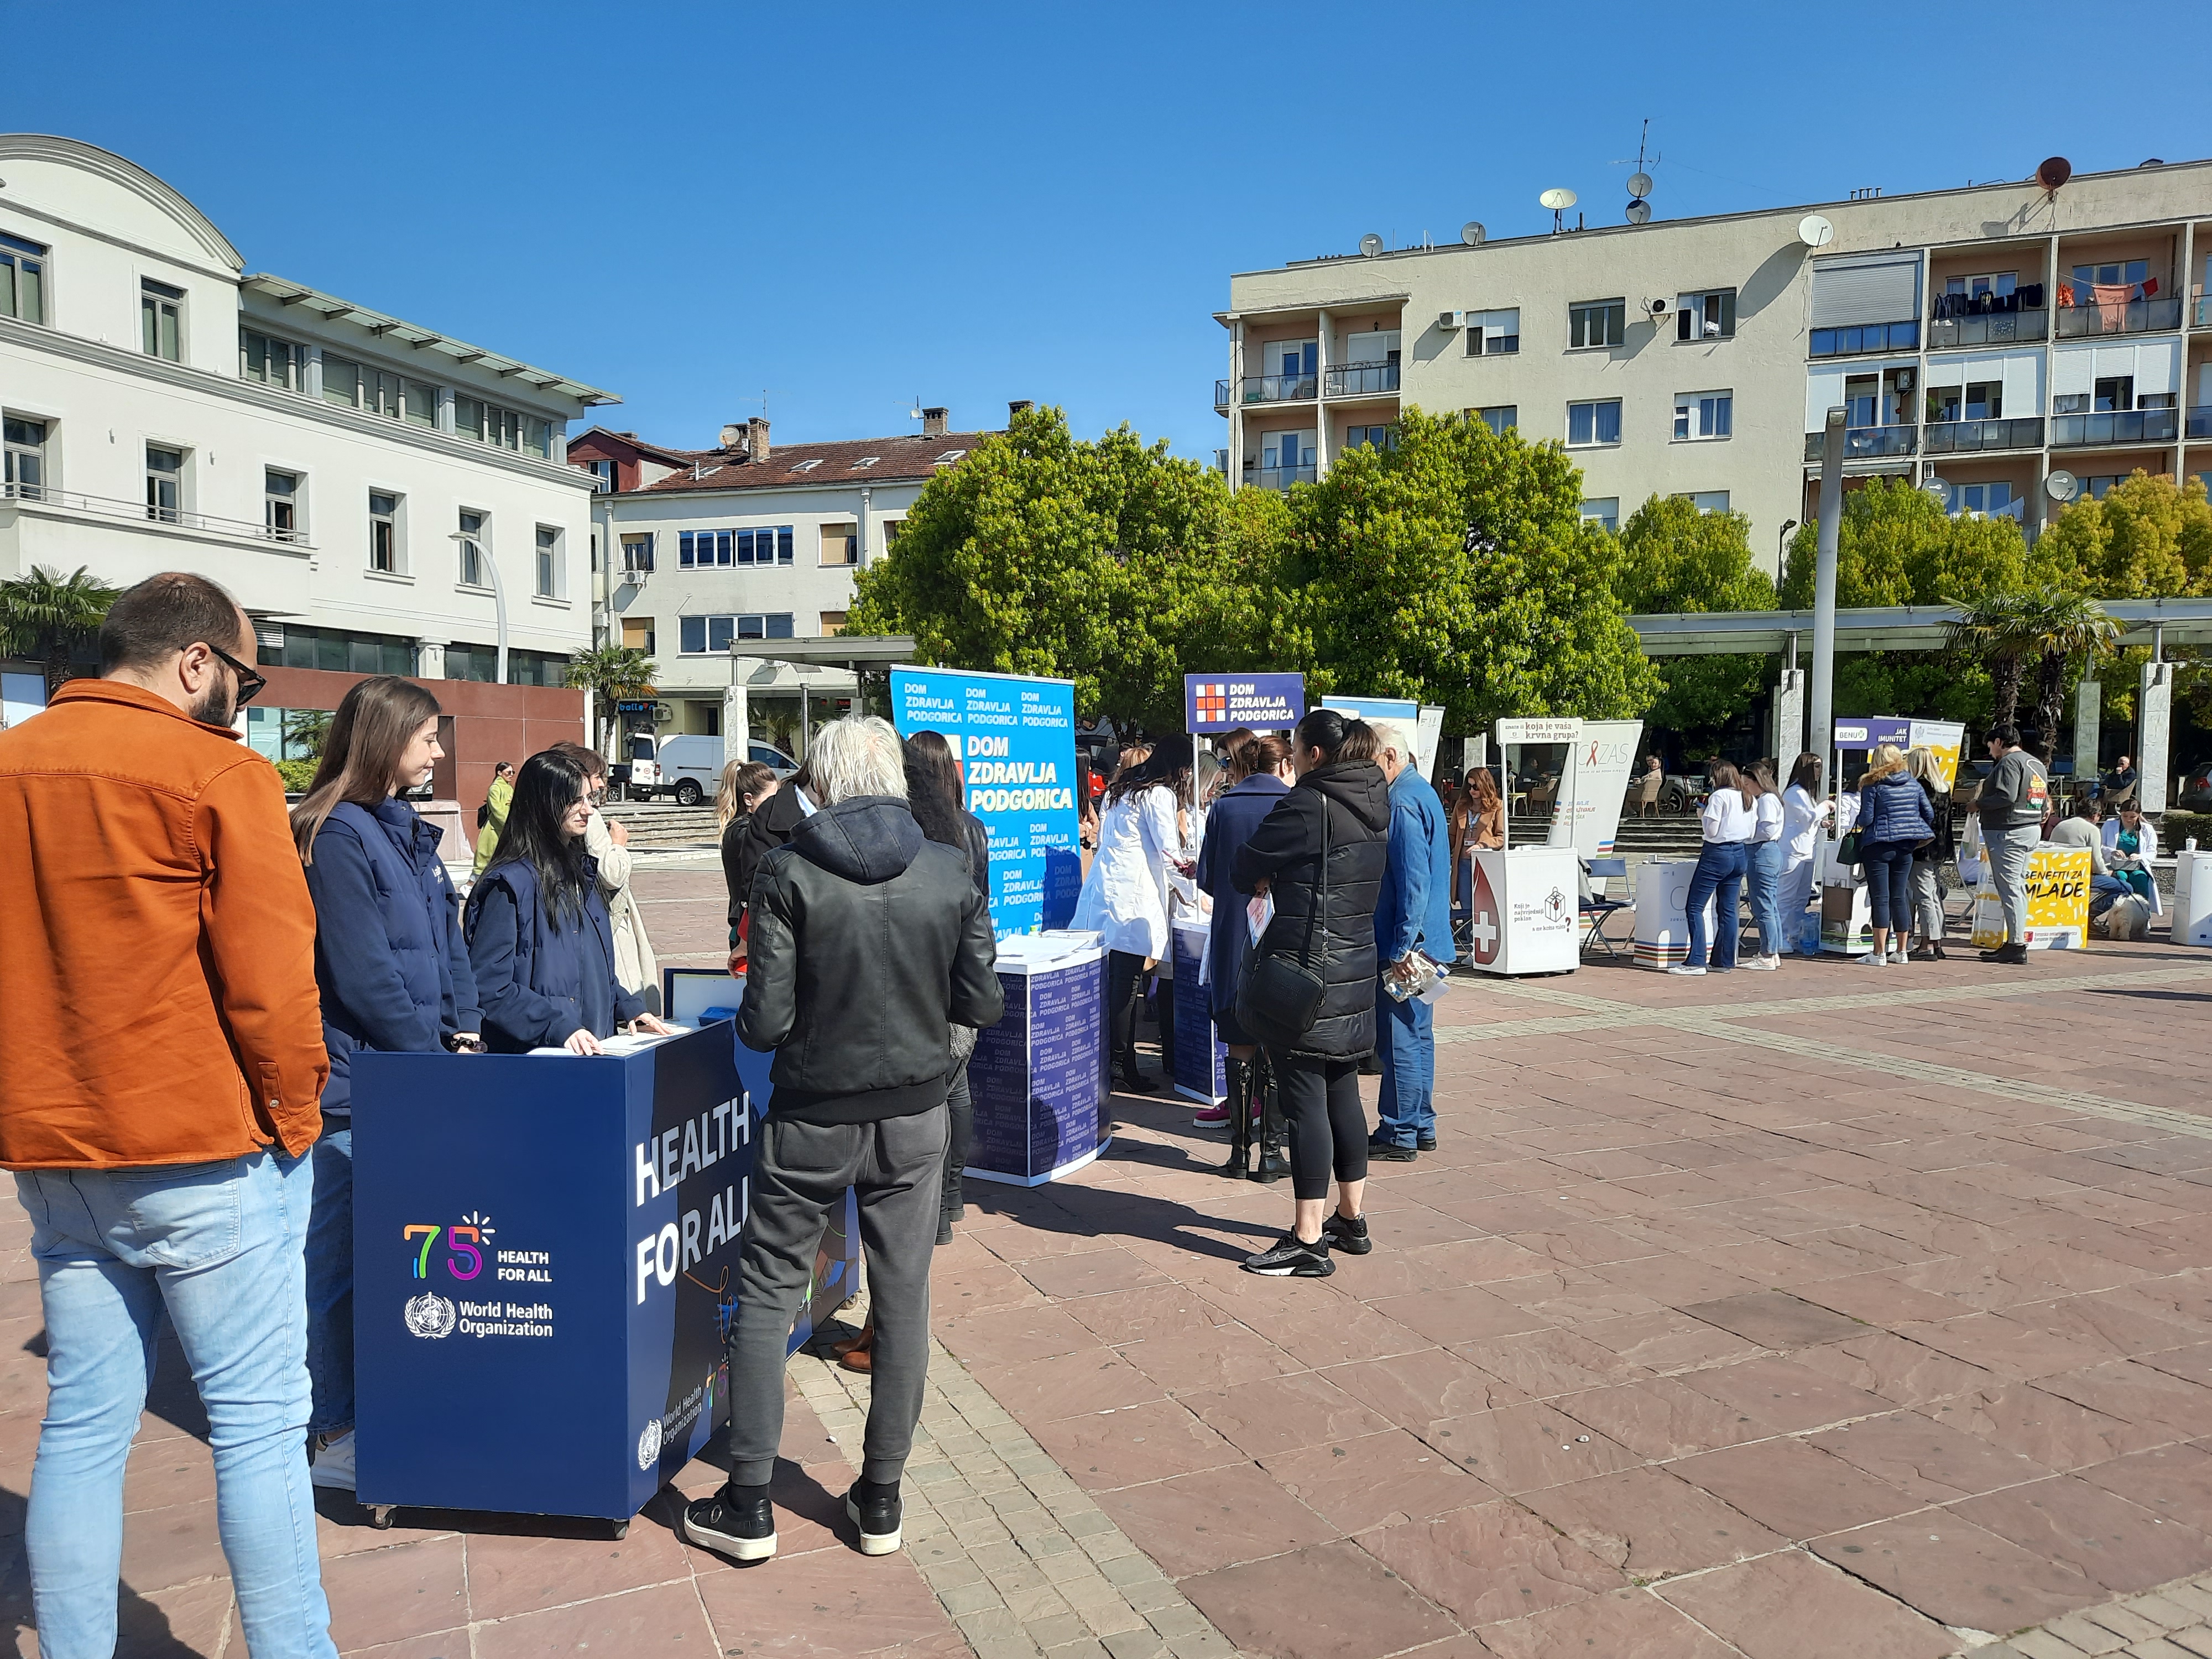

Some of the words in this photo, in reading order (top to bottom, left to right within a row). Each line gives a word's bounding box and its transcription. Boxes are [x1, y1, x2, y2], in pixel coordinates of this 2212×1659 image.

[904, 683, 927, 694] DOM
[966, 688, 986, 698] DOM
[1229, 684, 1255, 695] DOM
[905, 696, 954, 709] ZDRAVLJA
[1021, 692, 1039, 702] DOM
[1229, 696, 1286, 708] ZDRAVLJA
[966, 700, 1011, 712] ZDRAVLJA
[1021, 703, 1062, 715] ZDRAVLJA
[907, 710, 963, 723] PODGORICA
[967, 713, 1018, 726] PODGORICA
[1230, 709, 1294, 722] PODGORICA
[1022, 716, 1068, 728] PODGORICA
[1525, 722, 1543, 732] koja
[1546, 722, 1553, 732] je
[1554, 722, 1572, 730] vaša
[1525, 731, 1551, 739] krvna
[1553, 731, 1578, 740] grupa?
[968, 735, 1009, 758] DOM
[968, 761, 1057, 785] ZDRAVLJA
[969, 787, 1073, 812] PODGORICA
[1029, 823, 1047, 833] DOM
[988, 837, 1019, 848] RAVLJA
[1030, 833, 1068, 846] ZDRAVLJA
[989, 849, 1026, 862] DGORICA
[1031, 844, 1077, 858] PODGORICA
[1003, 869, 1022, 880] DOM
[1055, 865, 1072, 875] DOM
[2070, 870, 2083, 879] ZA
[1003, 879, 1045, 894] ZDRAVLJA
[1003, 891, 1051, 906] PODGORICA
[1065, 965, 1086, 976] ZDRAVLJA
[1031, 972, 1060, 983] ZDRAVLJA
[1031, 979, 1063, 991] PODGORICA
[1040, 992, 1052, 1000] DOM
[1040, 997, 1066, 1008] ZDRAVLJA
[1040, 1004, 1070, 1016] PODGORICA
[1031, 1022, 1045, 1031] DOM
[1031, 1027, 1060, 1039] ZDRAVLJA
[1031, 1034, 1063, 1047] PODGORICA
[1040, 1047, 1052, 1056] DOM
[1040, 1051, 1067, 1064] ZDRAVLJA
[1040, 1058, 1070, 1072] PODGORICA
[1031, 1078, 1045, 1087] DOM
[1031, 1082, 1060, 1095] ZDRAVLJA
[1031, 1088, 1063, 1103] PODGORICA
[1066, 1119, 1076, 1129] DOM
[1066, 1122, 1087, 1137] ZDRAVLJA
[637, 1092, 750, 1207] HEALTH
[1072, 1143, 1082, 1152] DOM
[404, 1224, 483, 1280] 75
[498, 1250, 549, 1264] HEALTH
[637, 1208, 701, 1305] FOR
[498, 1268, 525, 1281] FOR
[527, 1269, 552, 1282] ALL
[460, 1301, 501, 1317] World
[506, 1302, 552, 1319] Health
[460, 1318, 552, 1338] Organization
[663, 1401, 681, 1429] World
[683, 1384, 702, 1411] Health
[664, 1402, 702, 1446] Organization
